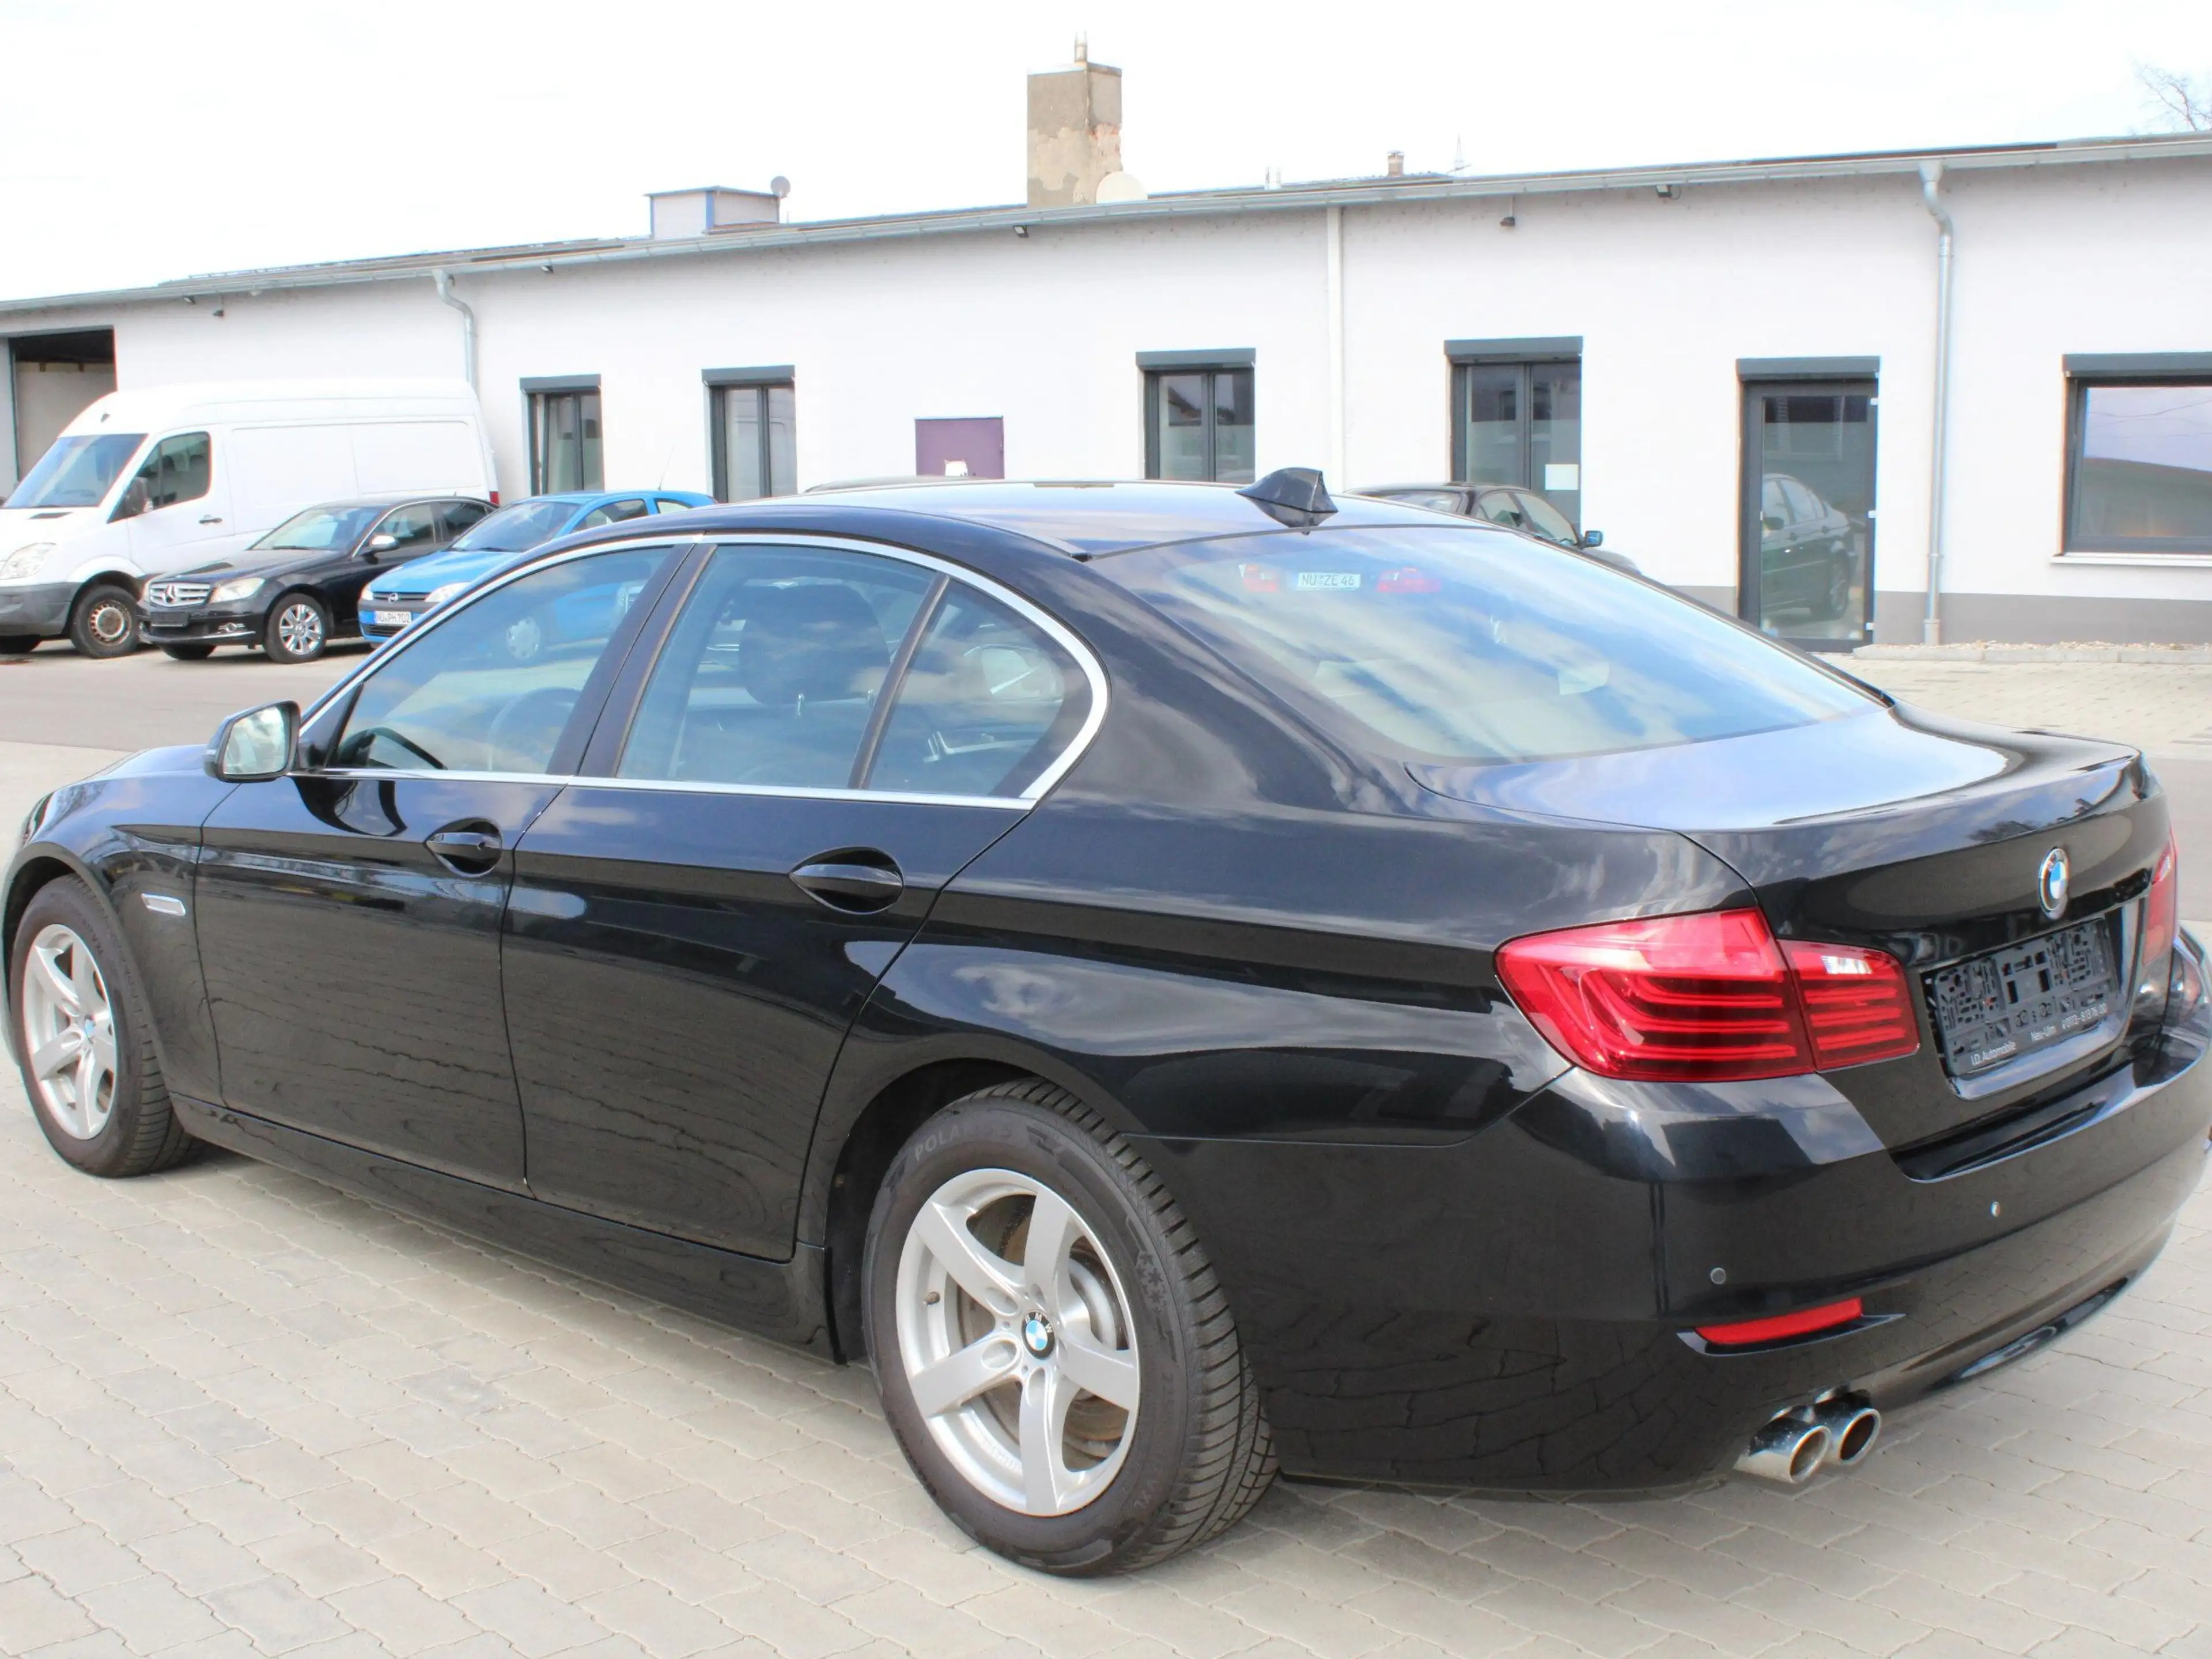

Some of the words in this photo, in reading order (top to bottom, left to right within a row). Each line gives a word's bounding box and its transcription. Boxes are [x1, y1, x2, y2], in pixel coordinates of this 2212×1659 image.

[1302, 573, 1317, 586] NU
[1324, 574, 1338, 586] ZE
[1341, 575, 1355, 586] 46
[1024, 1312, 1053, 1334] BMW
